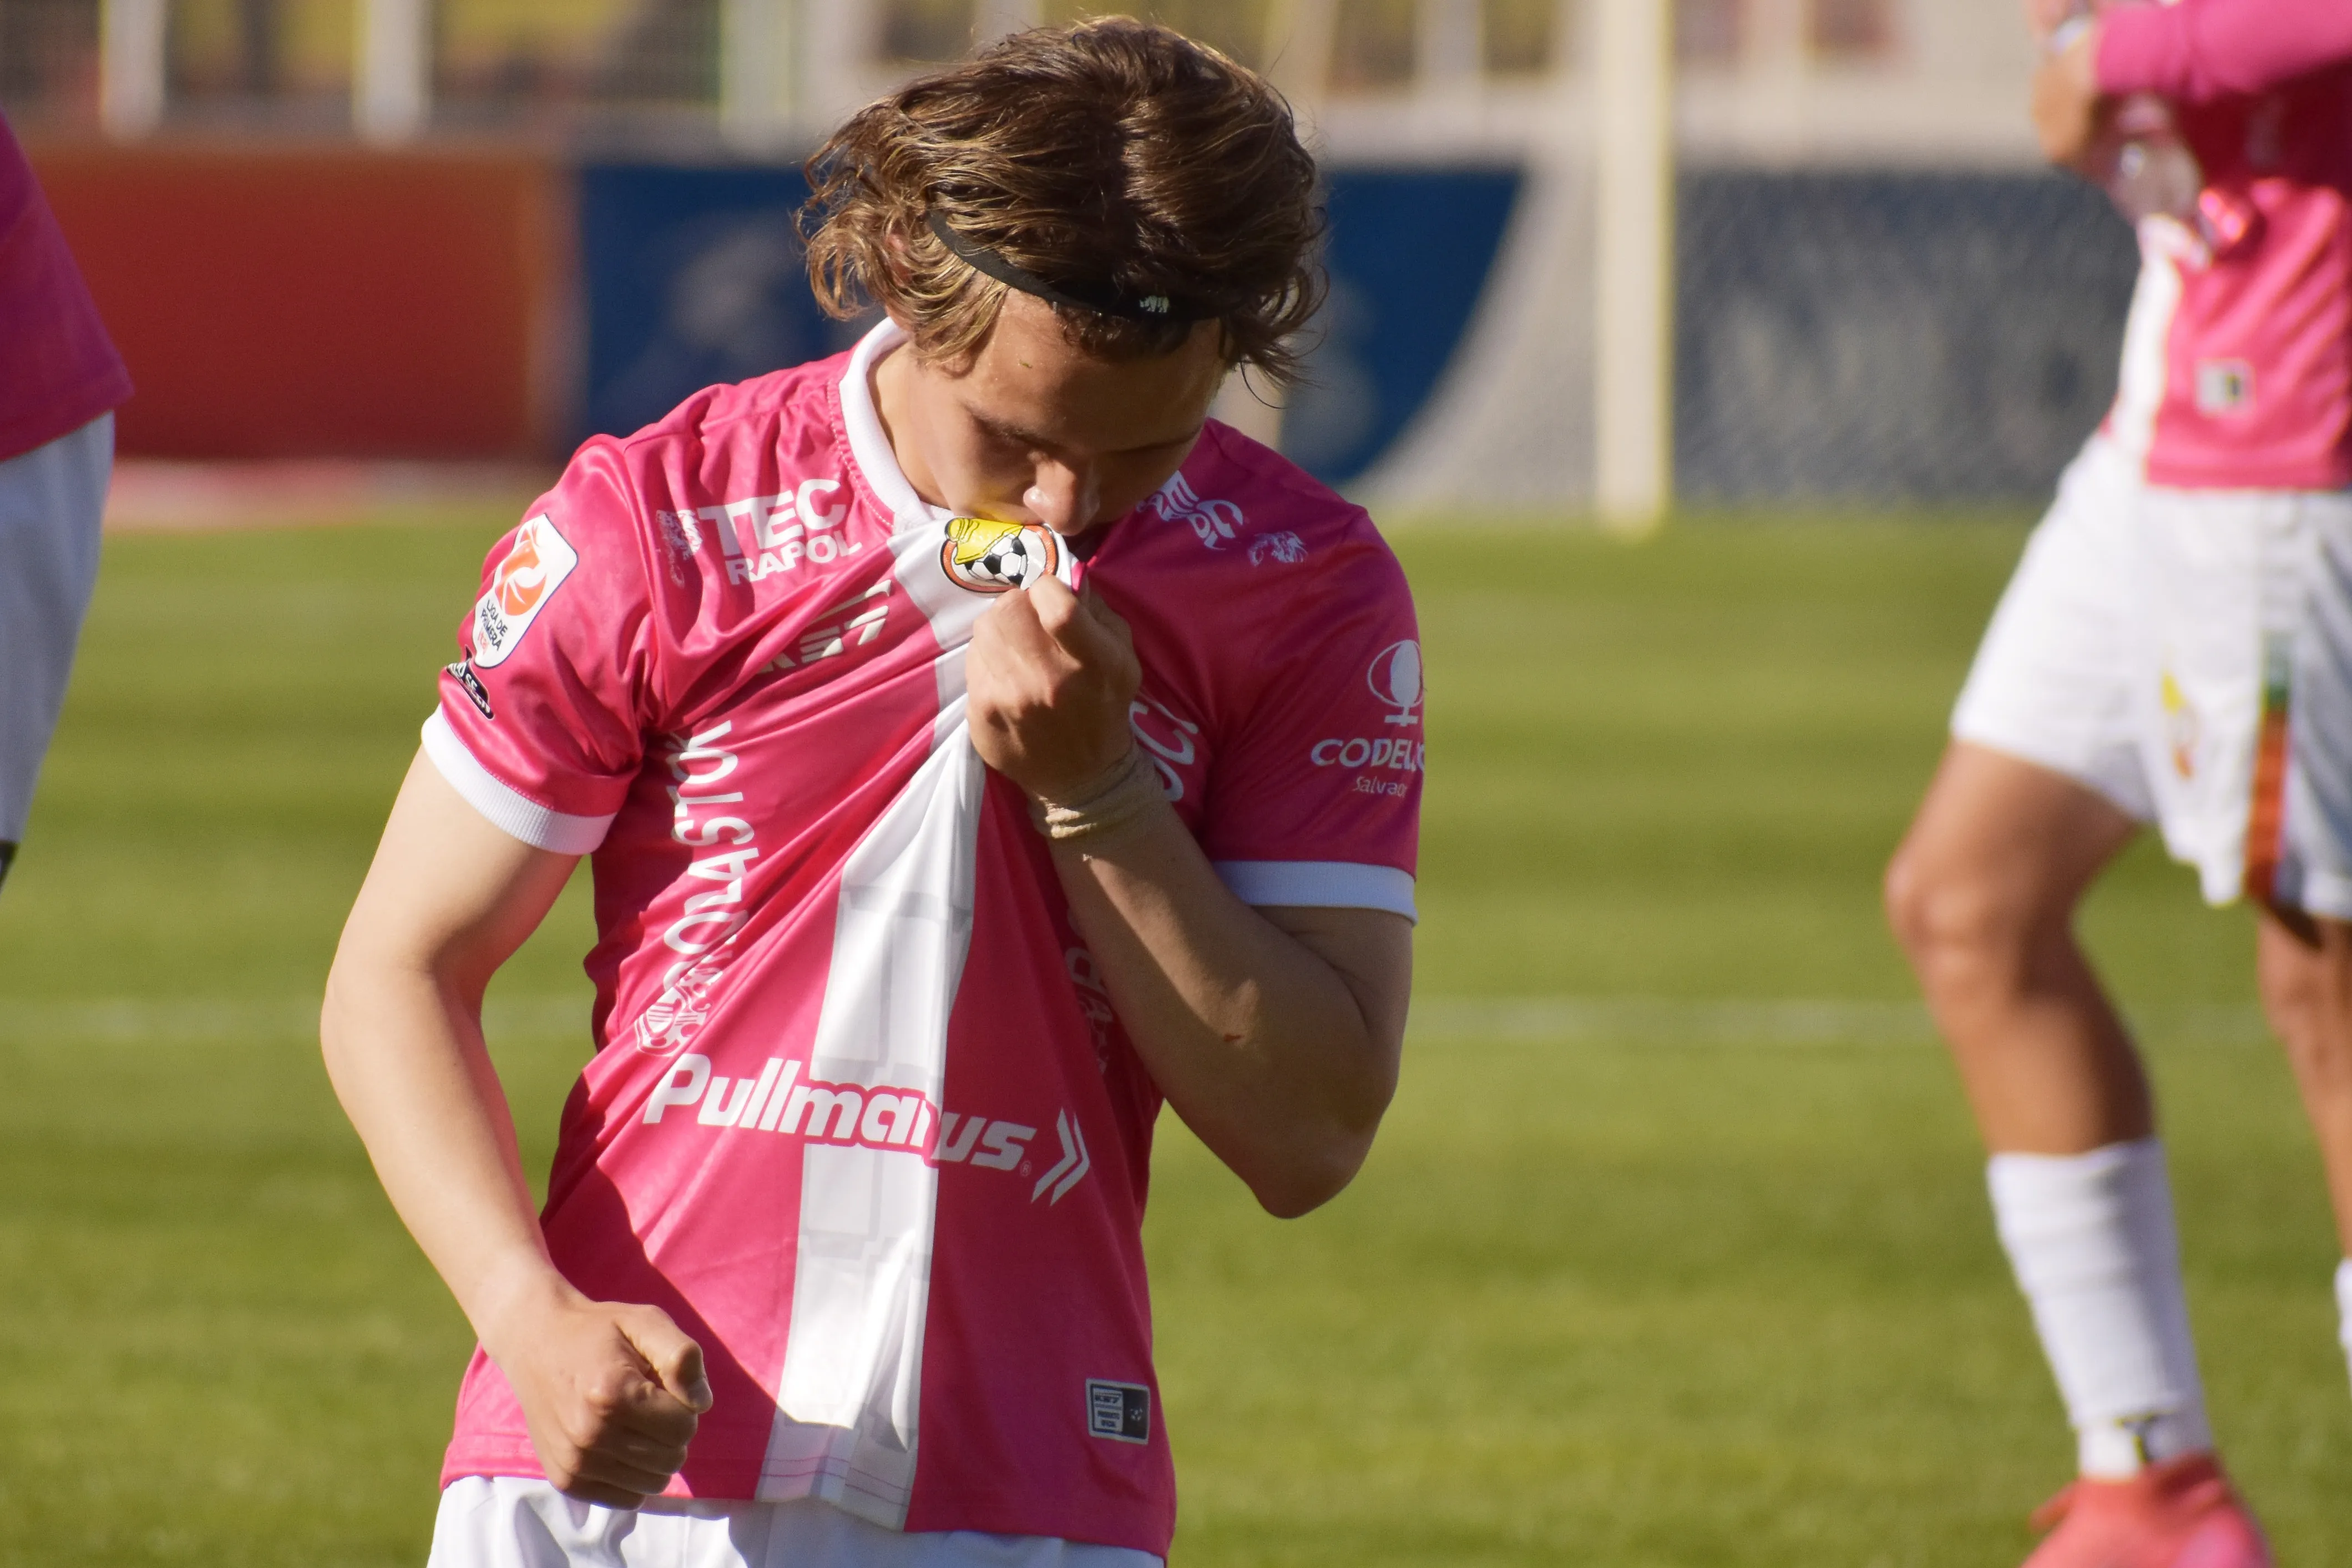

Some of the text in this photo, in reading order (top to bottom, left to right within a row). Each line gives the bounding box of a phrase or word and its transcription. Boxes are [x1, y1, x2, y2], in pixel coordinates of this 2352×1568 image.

[697, 479, 846, 556] TEC
[1160, 470, 1243, 538] EC
[725, 530, 862, 585] RAPOL
[495, 621, 508, 638] DE
